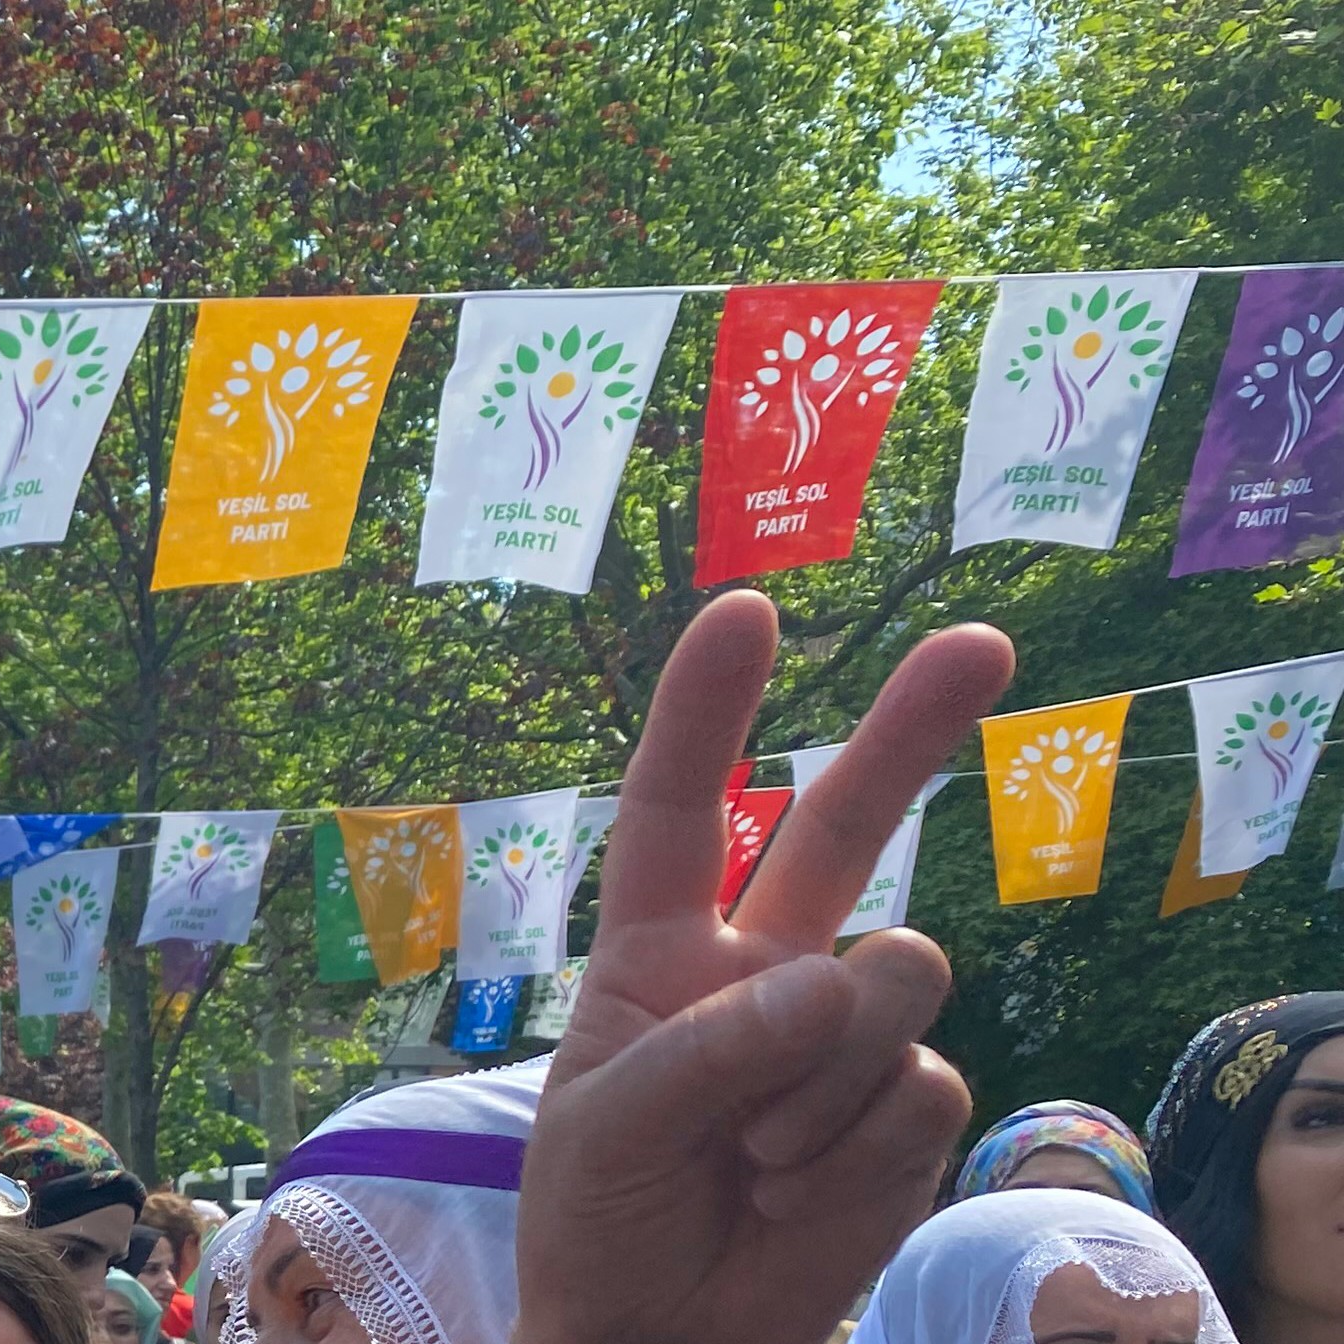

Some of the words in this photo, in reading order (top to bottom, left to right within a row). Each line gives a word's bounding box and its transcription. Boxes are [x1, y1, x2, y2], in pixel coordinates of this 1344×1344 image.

[1002, 461, 1057, 486] YEŞİL
[1064, 465, 1108, 487] SOL
[13, 479, 43, 499] SOL
[745, 484, 792, 512] YEŞİL
[795, 482, 829, 503] SOL
[1012, 491, 1080, 513] PARTİ
[1230, 478, 1277, 503] YEŞİL
[1280, 477, 1314, 497] SOL
[217, 492, 270, 518] YEŞİL
[275, 492, 311, 511] SOL
[482, 498, 537, 523] YEŞİL
[542, 504, 582, 528] SOL
[1235, 501, 1290, 528] PARTİ
[231, 517, 290, 544] PARTİ
[755, 508, 809, 539] PARTİ
[494, 531, 557, 552] PARTİ
[874, 877, 898, 891] SOL
[488, 926, 522, 943] YEŞİL
[526, 925, 547, 939] SOL
[500, 942, 536, 959] PARTİ
